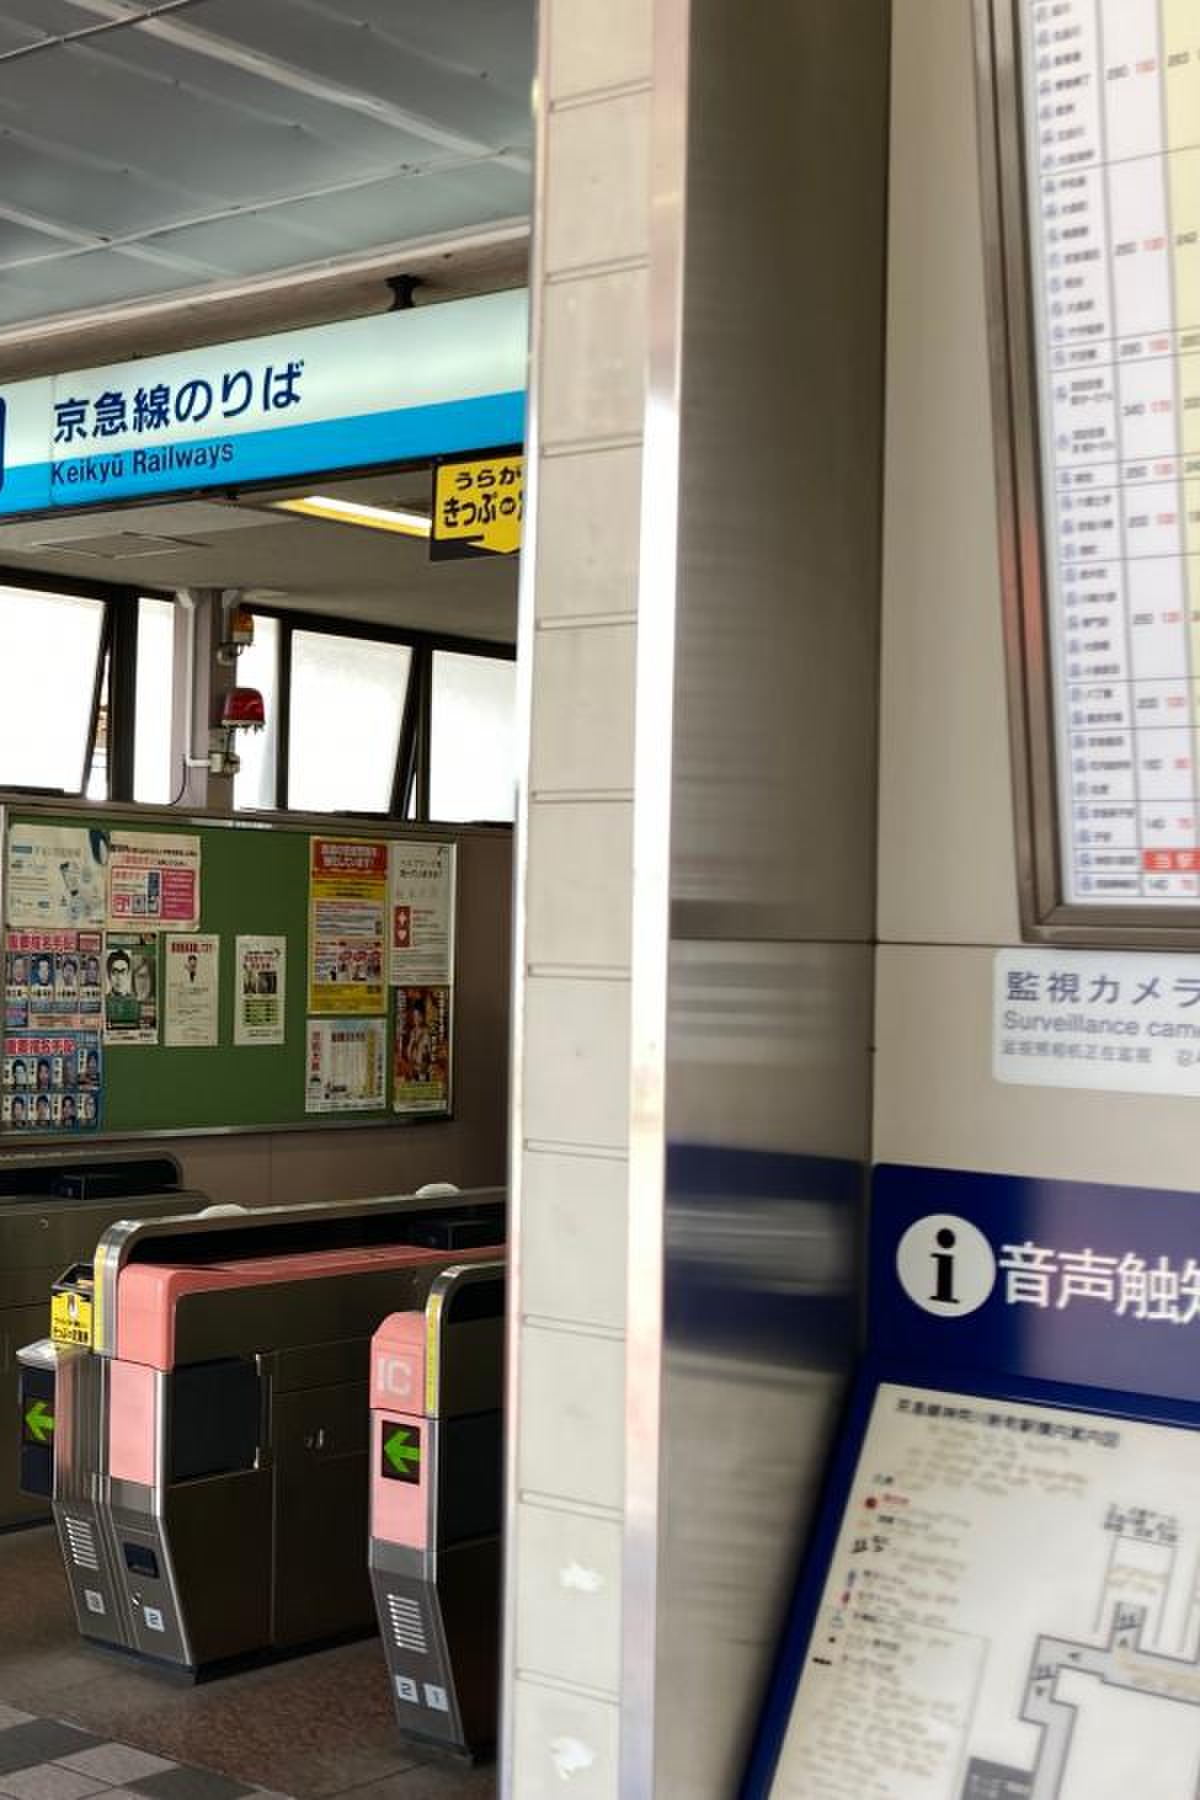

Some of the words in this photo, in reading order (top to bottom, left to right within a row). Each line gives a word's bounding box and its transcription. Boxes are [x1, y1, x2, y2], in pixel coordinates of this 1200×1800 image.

[53, 360, 304, 443] 京急線のりば
[133, 440, 234, 474] Railways
[1007, 971, 1200, 1009] 監視カメラ
[1003, 1009, 1139, 1036] Surveillance
[376, 1357, 412, 1396] IC
[400, 1681, 413, 1697] 2
